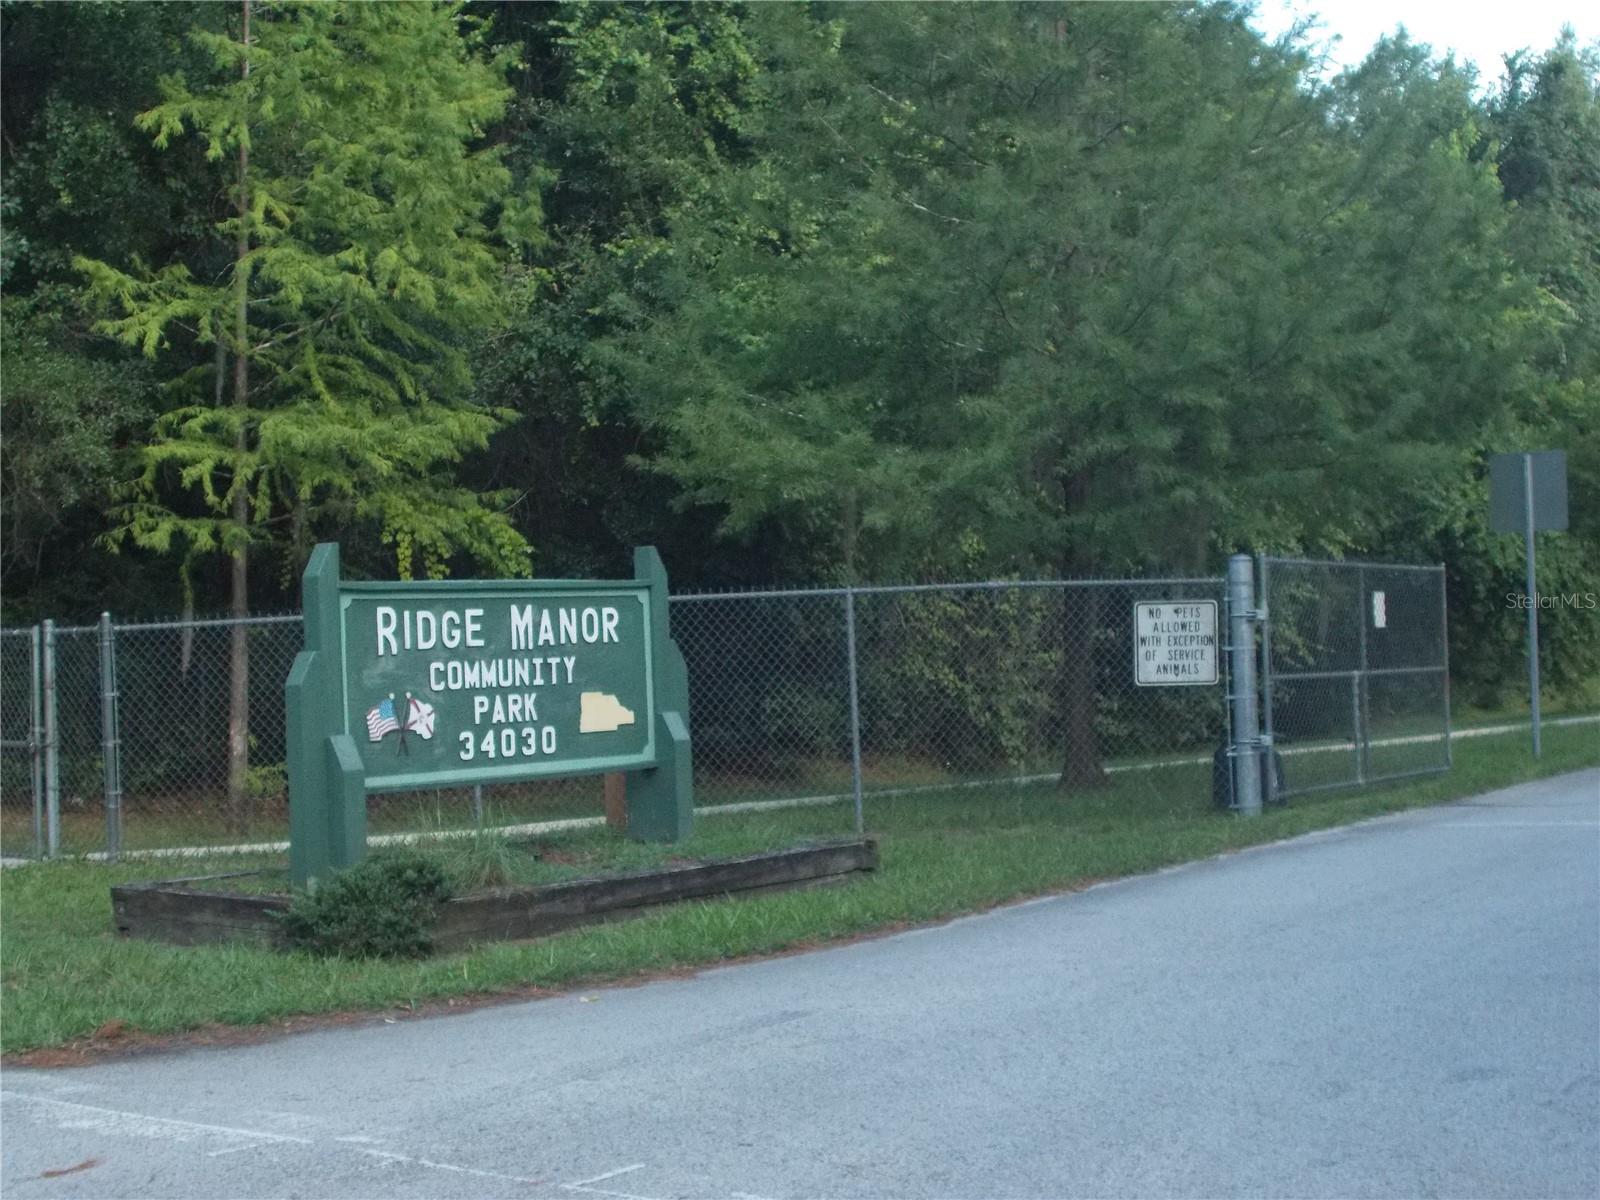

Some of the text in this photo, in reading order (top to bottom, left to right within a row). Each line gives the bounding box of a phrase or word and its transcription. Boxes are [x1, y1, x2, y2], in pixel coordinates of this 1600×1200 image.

[1148, 607, 1201, 619] NO PETS
[376, 604, 619, 656] RIDGE MANOR
[1153, 621, 1200, 633] ALLOWED
[1140, 635, 1214, 647] WITH EXCEPTION
[1145, 649, 1206, 661] OF SERVICE
[429, 656, 576, 691] COMMUNITY
[1156, 663, 1199, 675] ANIMALS
[474, 692, 538, 724] PARK
[458, 726, 557, 760] 34030
